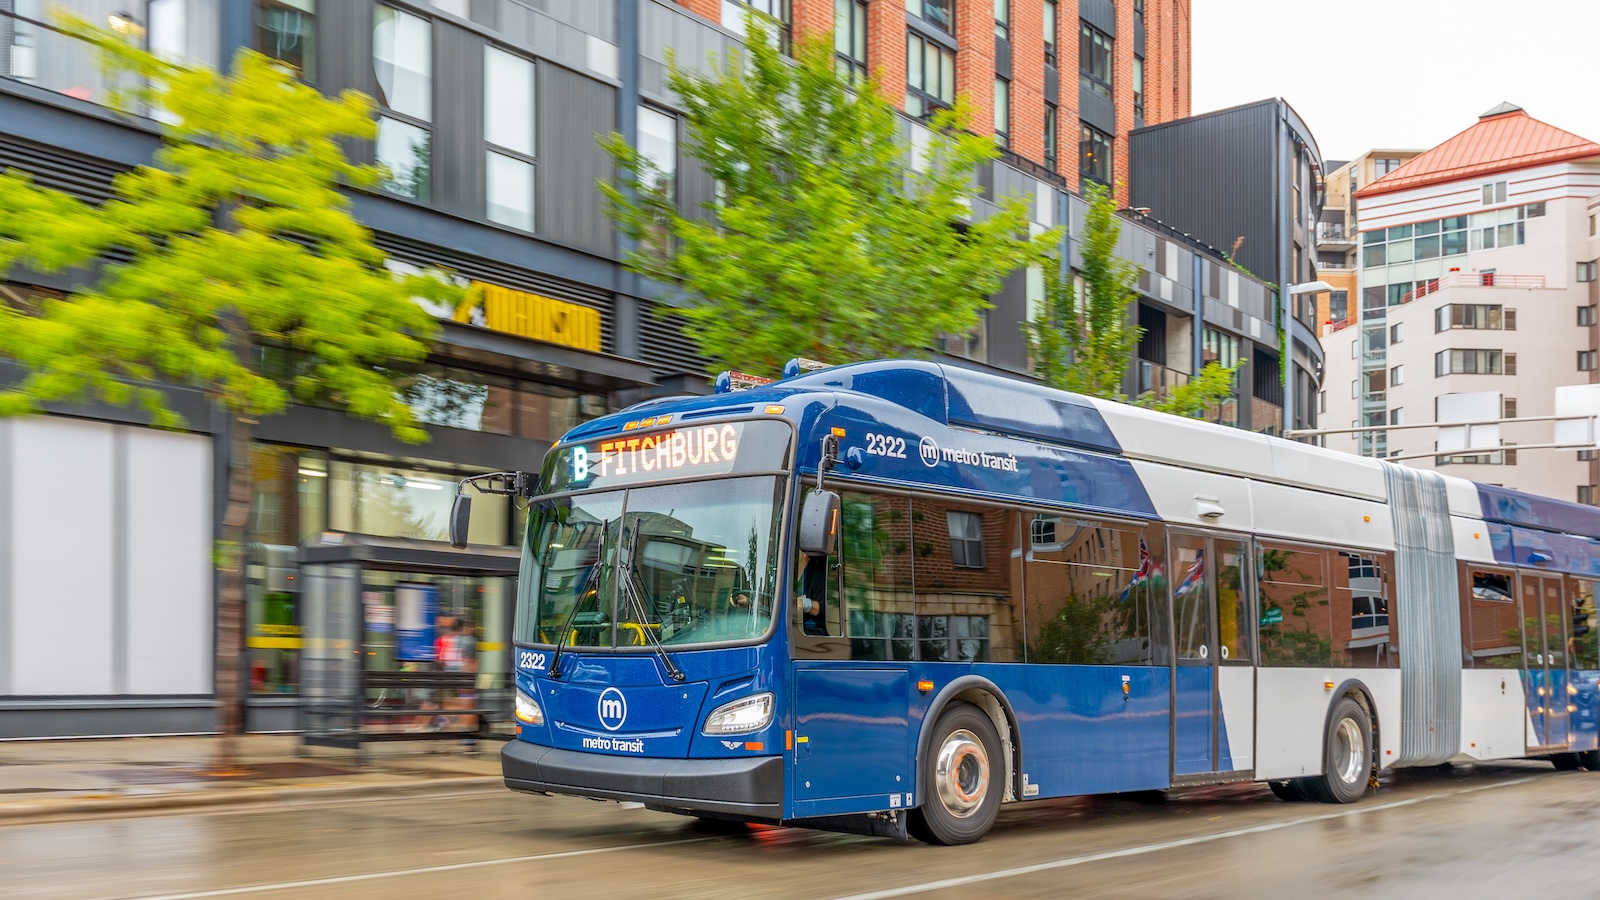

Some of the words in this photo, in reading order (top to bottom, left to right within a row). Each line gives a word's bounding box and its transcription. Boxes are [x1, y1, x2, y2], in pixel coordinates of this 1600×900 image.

[574, 446, 588, 481] B
[601, 424, 737, 477] FITCHBURG
[866, 432, 907, 459] 2322
[942, 447, 980, 467] metro
[981, 451, 1018, 473] transit
[520, 652, 546, 670] 2322
[582, 737, 611, 750] metro
[612, 738, 644, 753] transit
